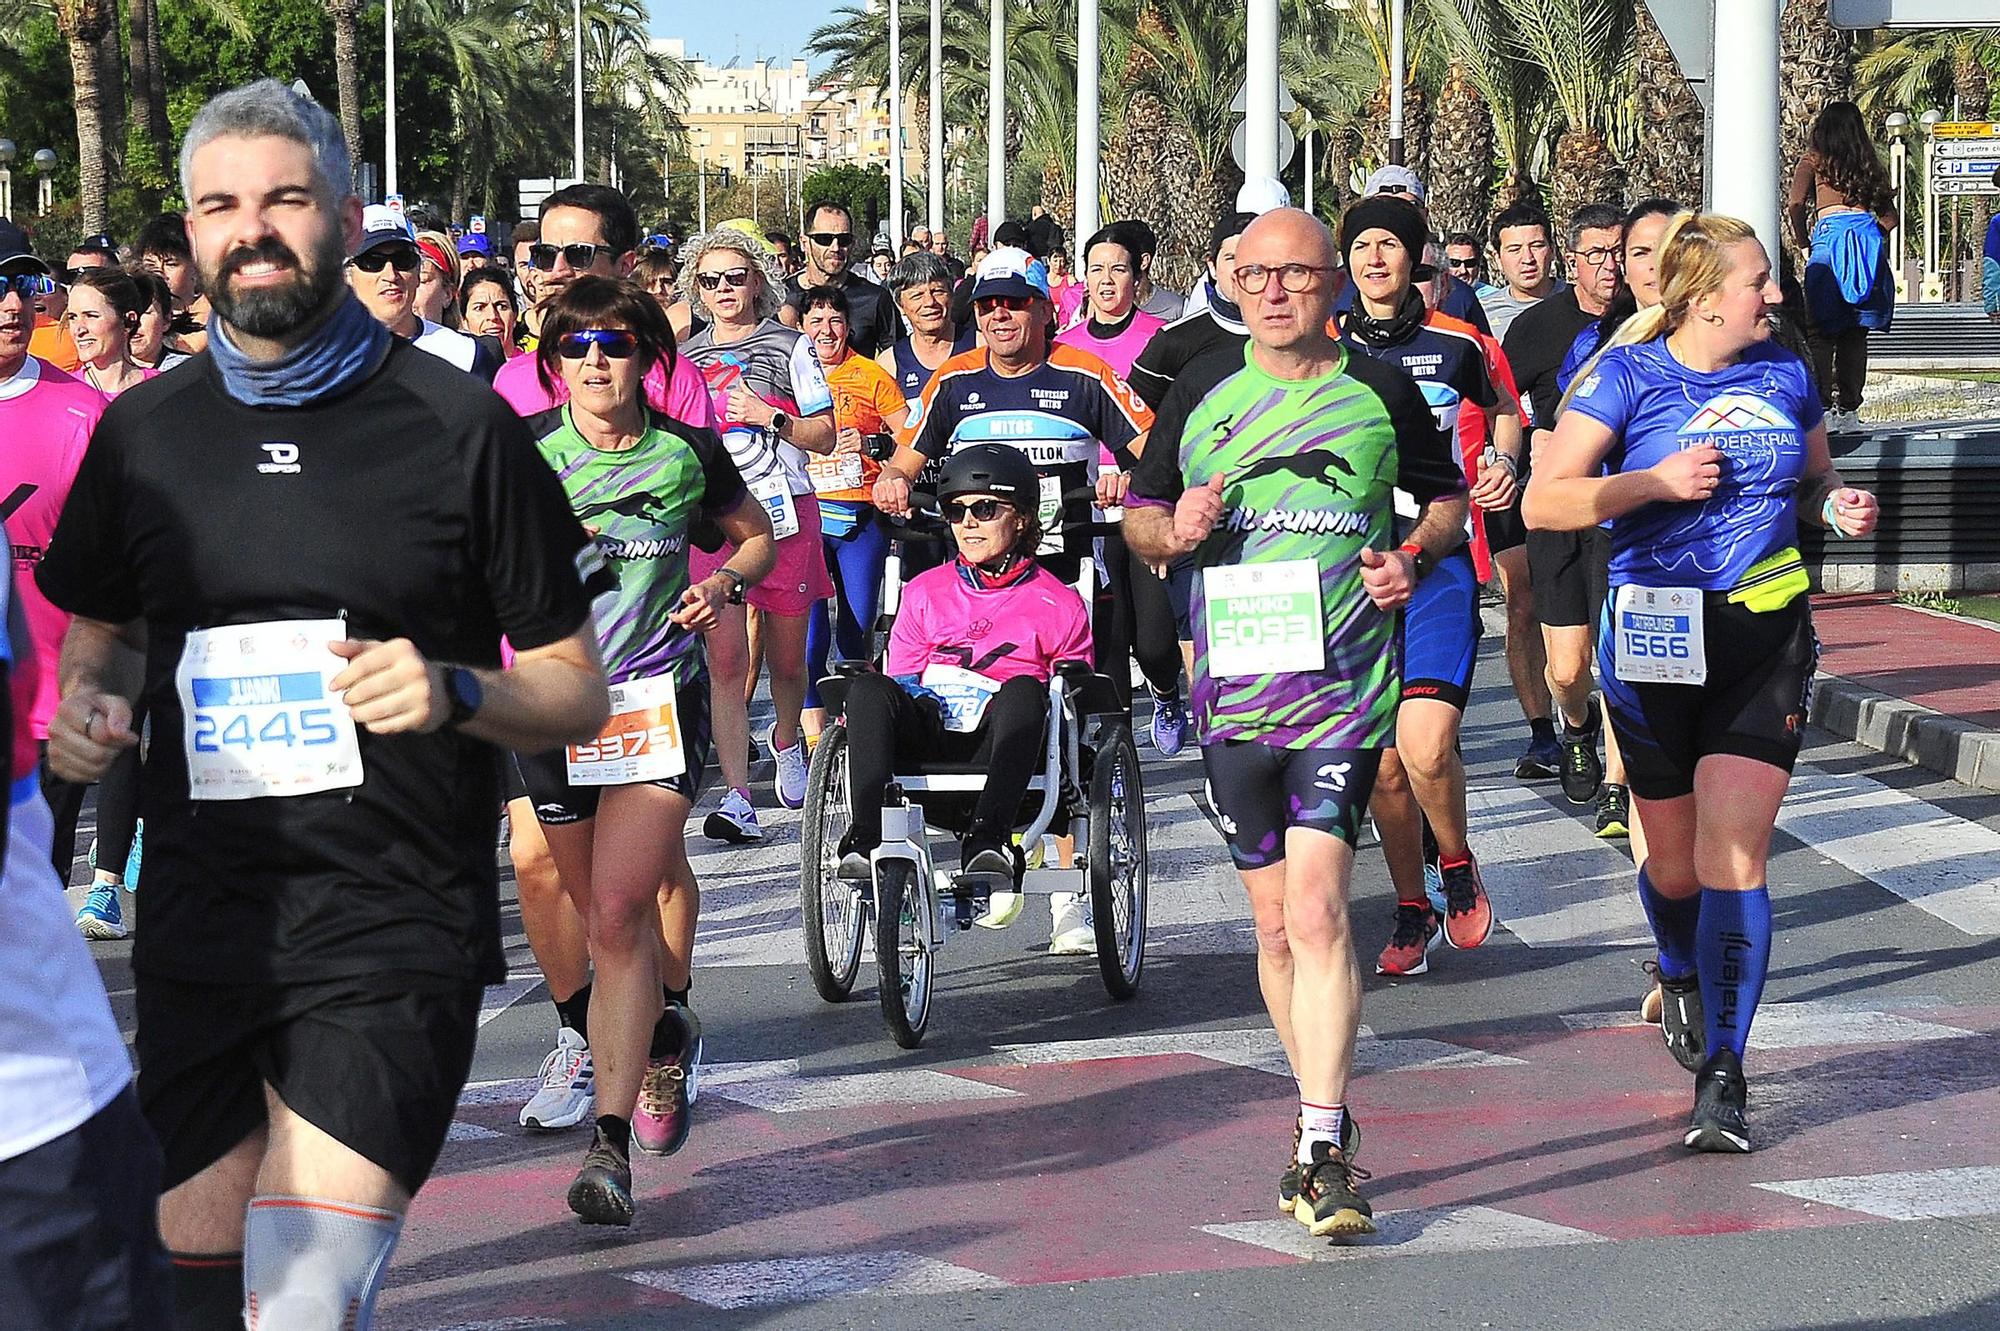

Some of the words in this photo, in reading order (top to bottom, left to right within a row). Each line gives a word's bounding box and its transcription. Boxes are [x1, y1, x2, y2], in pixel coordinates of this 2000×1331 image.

[990, 419, 1034, 435] MITOS
[1757, 432, 1800, 447] TRAIL
[1213, 506, 1257, 533] EAL
[1259, 507, 1371, 537] RUNNING
[1227, 594, 1293, 616] PAKIKO
[1214, 615, 1313, 648] 5093
[1623, 632, 1690, 659] 1566
[194, 708, 337, 752] 2445
[575, 723, 675, 763] 5375
